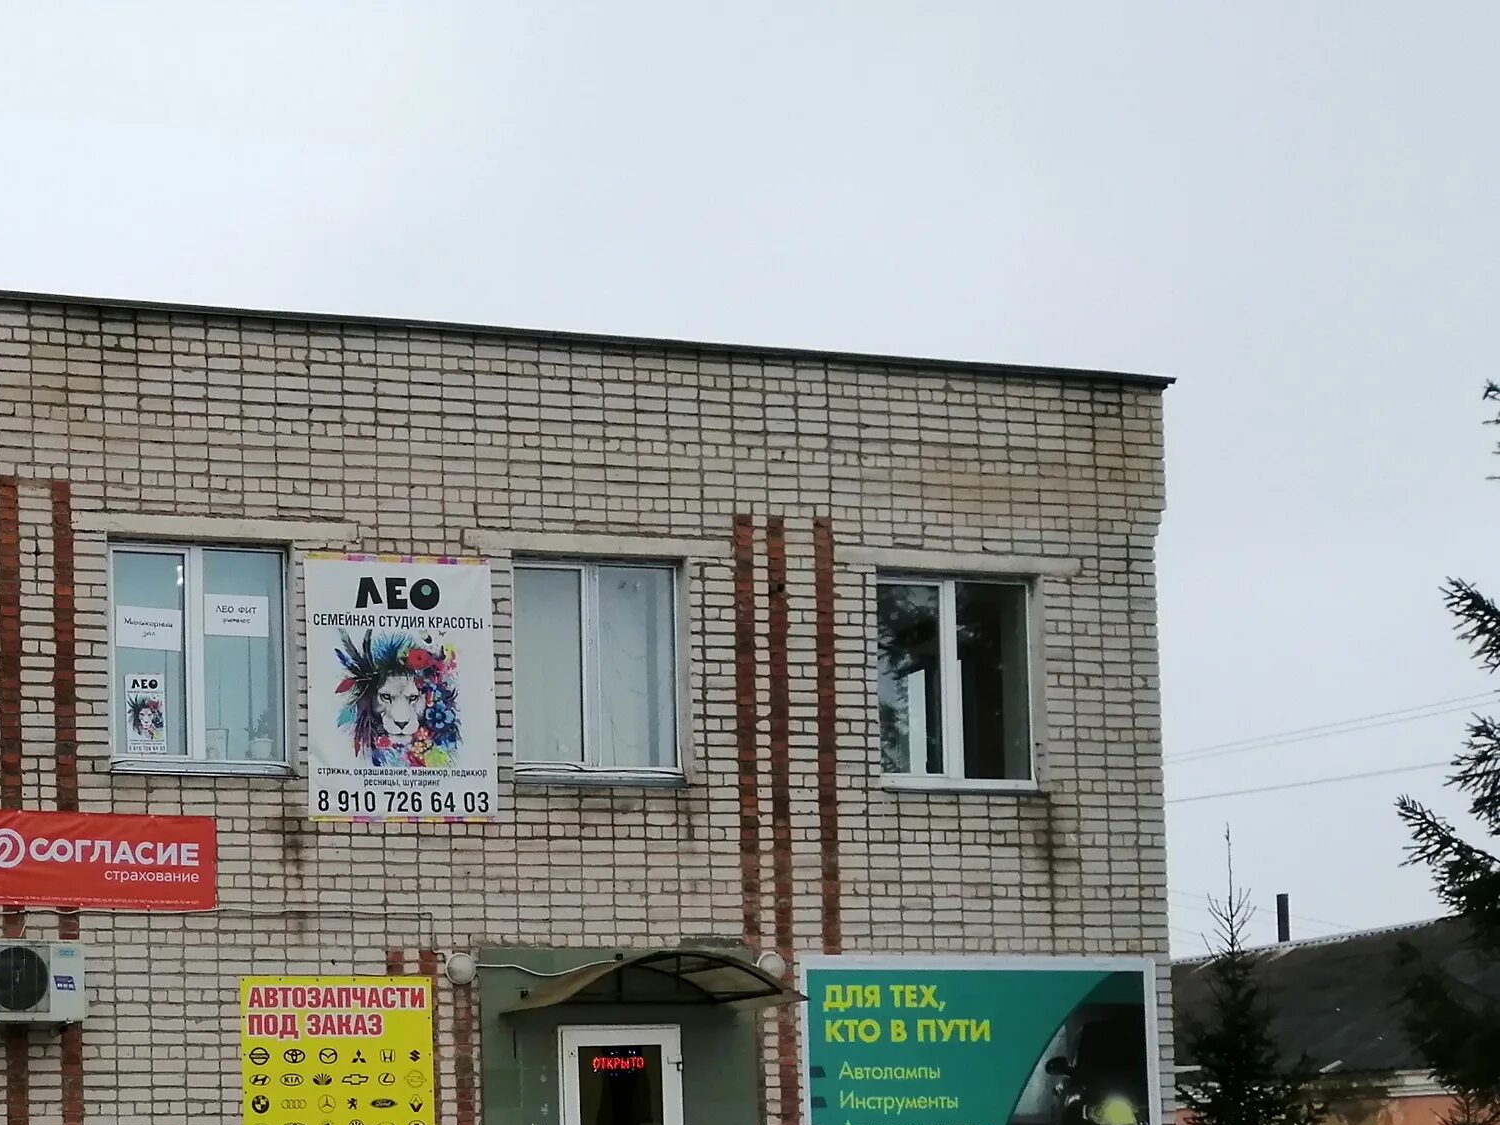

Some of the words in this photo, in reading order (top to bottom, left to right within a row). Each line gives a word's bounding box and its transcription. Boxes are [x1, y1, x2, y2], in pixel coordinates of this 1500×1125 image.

[355, 577, 440, 610] ЛЕО
[238, 605, 257, 615] ФИТ
[313, 611, 375, 627] СЕМЕЙНАЯ
[378, 615, 425, 630] СТУДИЯ
[428, 616, 483, 630] КРАСОТЫ
[131, 679, 158, 689] ЛЕО
[402, 779, 440, 788] шугаринг
[451, 770, 487, 778] педикюр
[318, 790, 329, 812] 8
[338, 790, 376, 812] 910
[384, 791, 422, 813] 726
[430, 791, 456, 813] 64
[464, 791, 489, 813] 03
[29, 838, 200, 866] СОГЛАСИЕ
[104, 870, 200, 883] страхование
[248, 987, 425, 1008] АВТОЗАПЧАСТИ
[823, 985, 881, 1012] ДЛЯ
[889, 985, 946, 1011] ТЕХ,
[248, 1014, 299, 1039] ПОД
[307, 1014, 382, 1036] ЗАКАЗ
[825, 1018, 881, 1043] КТО
[890, 1019, 908, 1043] В
[917, 1019, 991, 1042] ПУТИ
[592, 1056, 645, 1070] ОТКРЫТО
[839, 1060, 941, 1080] Автолампы
[840, 1090, 959, 1115] Инструменты
